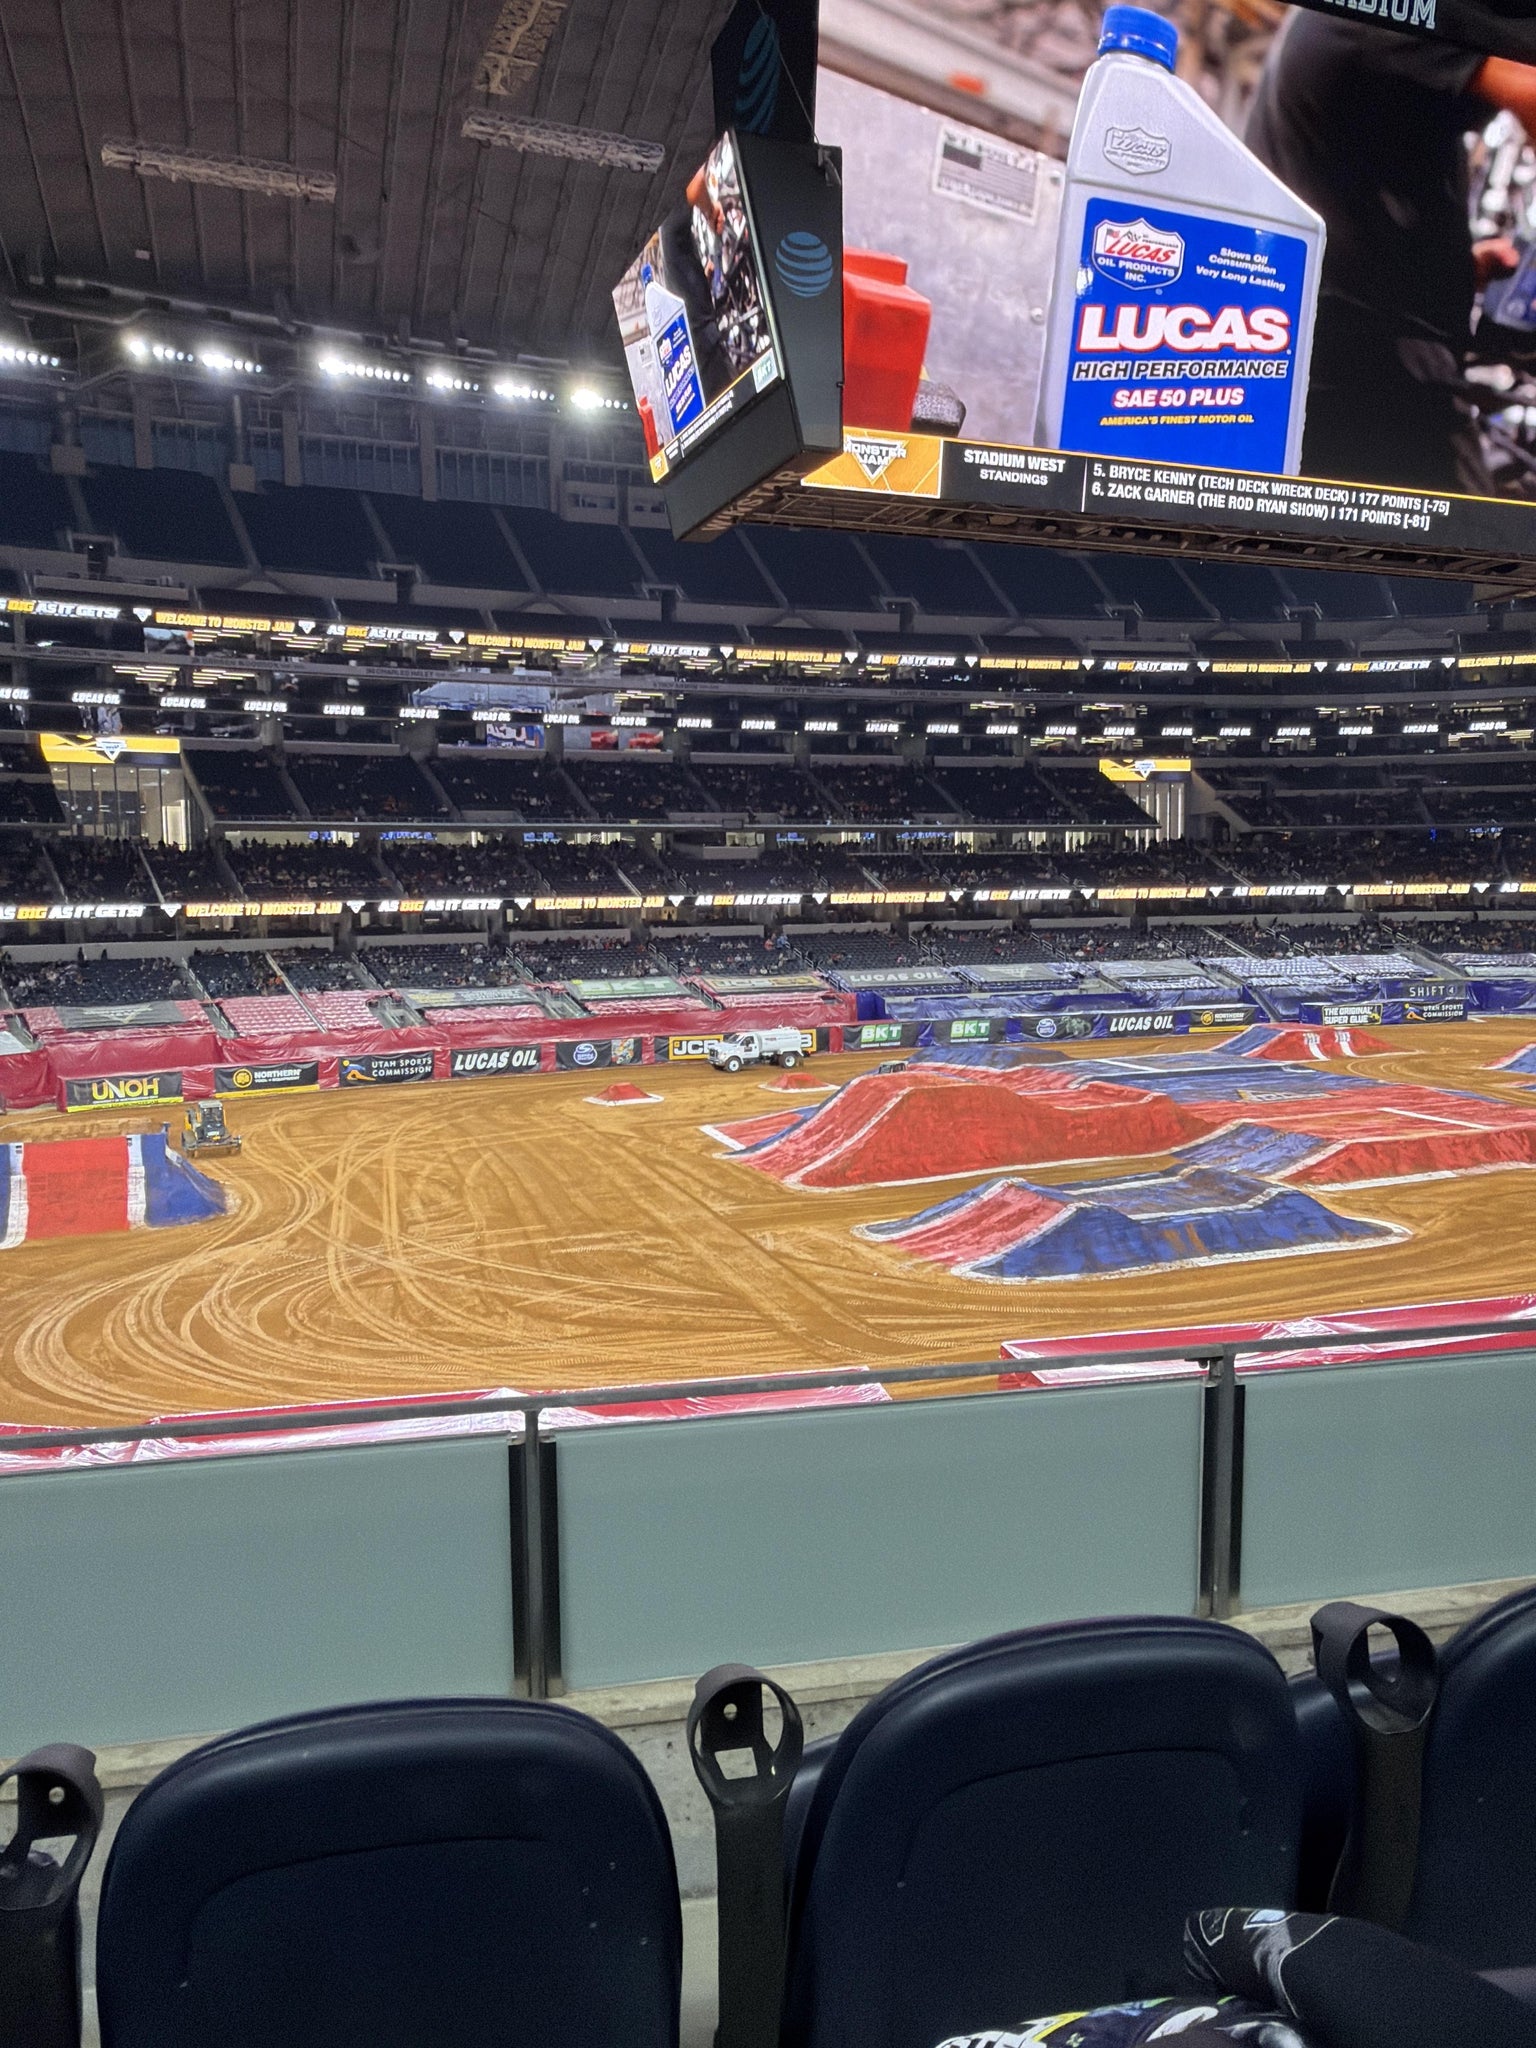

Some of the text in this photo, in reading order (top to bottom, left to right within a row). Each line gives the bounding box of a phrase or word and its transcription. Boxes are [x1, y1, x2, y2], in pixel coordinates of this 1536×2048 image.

[1323, 0, 1436, 30] DIUM
[1105, 240, 1177, 263] LUCAS
[1220, 247, 1269, 264] Slows Oil
[1097, 257, 1175, 277] OIL PRODUCTS
[1208, 254, 1277, 275] Consumption
[1124, 272, 1147, 283] INC.
[1196, 265, 1286, 292] Very Long Lasting
[1077, 304, 1291, 352] LUCAS
[665, 345, 693, 397] LUCAS
[1073, 359, 1289, 381] HIGH PERFORMANCE
[1113, 387, 1245, 408] SAE 50 PLUS
[1100, 415, 1254, 426] AMERICA'S FINEST MOTOR OIL
[859, 453, 890, 465] JAM
[964, 449, 1066, 473] STADIUM WEST
[979, 468, 1048, 486] STANDINGS
[1093, 463, 1106, 477] 5.
[1109, 464, 1151, 482] BRYCE
[1153, 469, 1196, 487] KENNY
[1198, 474, 1235, 490] (TECH
[1236, 479, 1269, 494] DECK
[1271, 482, 1313, 499] WRECK
[1315, 487, 1349, 505] DECK)
[1359, 492, 1380, 506] 177
[1381, 494, 1422, 511] POINTS
[1423, 498, 1451, 515] [-75]
[1091, 481, 1105, 496] 6.
[1107, 482, 1142, 500] ZACK
[1144, 489, 1195, 506] GARNER
[1197, 492, 1226, 509] (THE
[1228, 495, 1254, 511] ROD
[1256, 498, 1287, 514] RYAN
[1290, 503, 1329, 521] SHOW)
[1338, 508, 1358, 521] 171
[1361, 509, 1401, 525] POINTS
[1403, 513, 1430, 531] [-81]
[156, 611, 295, 633] WELCOME TO MONSTER JAM
[468, 634, 510, 647] WELCOME
[524, 638, 565, 650] MONSTER
[565, 640, 585, 651] JAM
[12, 689, 29, 700] OIL
[72, 692, 121, 705] LUCAS OIL
[160, 697, 206, 709] LUCAS OIL
[244, 701, 287, 713] LUCAS OIL
[323, 705, 365, 716] LUCAS OIL
[399, 708, 439, 719] LUCAS OIL
[48, 905, 74, 919] AS
[74, 904, 94, 919] IT
[94, 903, 145, 918] GETS!
[186, 901, 342, 917] WELCOME TO MONSTER JAM
[378, 900, 399, 911] AS
[424, 899, 444, 911] AS
[444, 899, 461, 911] IT
[534, 898, 581, 910] WELCOME
[643, 896, 665, 908] JAM
[850, 971, 943, 983] LUCAS OIL
[1409, 985, 1445, 997] SHIFT
[1324, 1007, 1372, 1016] THE ORIGINAL
[1324, 1015, 1369, 1024] SUPER GLUE
[1423, 1010, 1463, 1018] COMMISSION
[952, 1021, 990, 1036] BKT
[1110, 1015, 1174, 1032] LUCAS OIL
[862, 1025, 901, 1041] BKT
[371, 1057, 432, 1069] UTAH SPORTS
[454, 1049, 538, 1071] LUCAS OIL
[254, 1069, 301, 1079] NORTHERN
[371, 1066, 432, 1078] COMMISSION
[92, 1078, 159, 1100] UNOH
